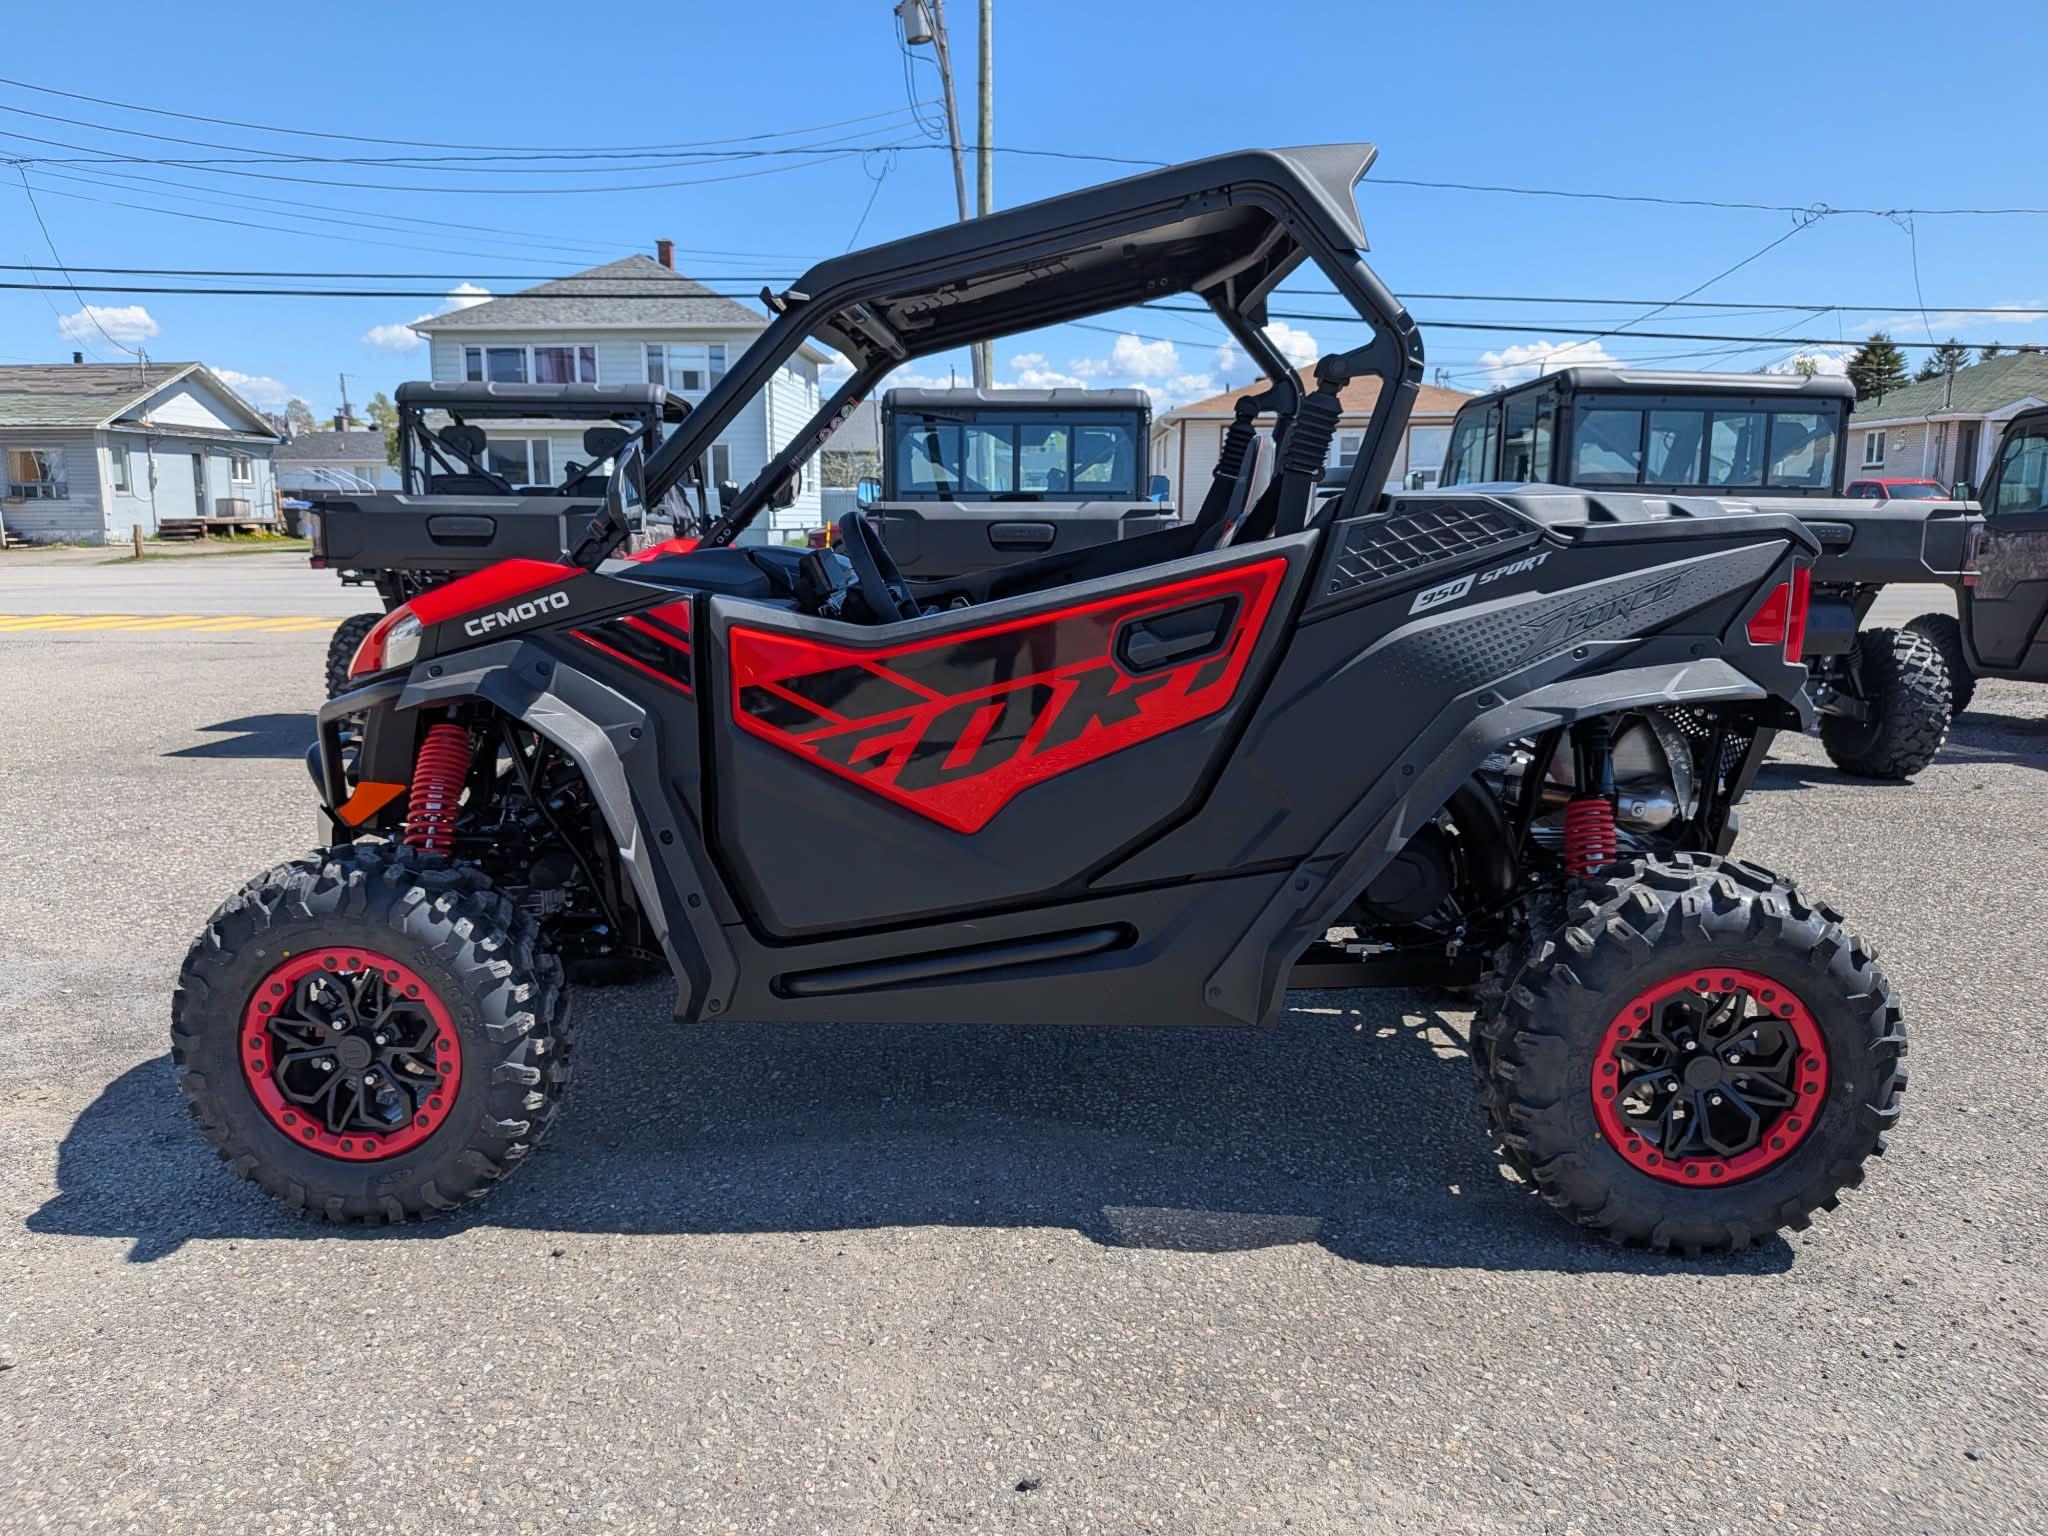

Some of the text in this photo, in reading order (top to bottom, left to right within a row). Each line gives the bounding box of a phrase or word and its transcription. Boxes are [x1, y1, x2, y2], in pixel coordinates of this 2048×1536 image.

[1419, 551, 1552, 607] 950 SPORT
[464, 591, 570, 637] CFMOTO
